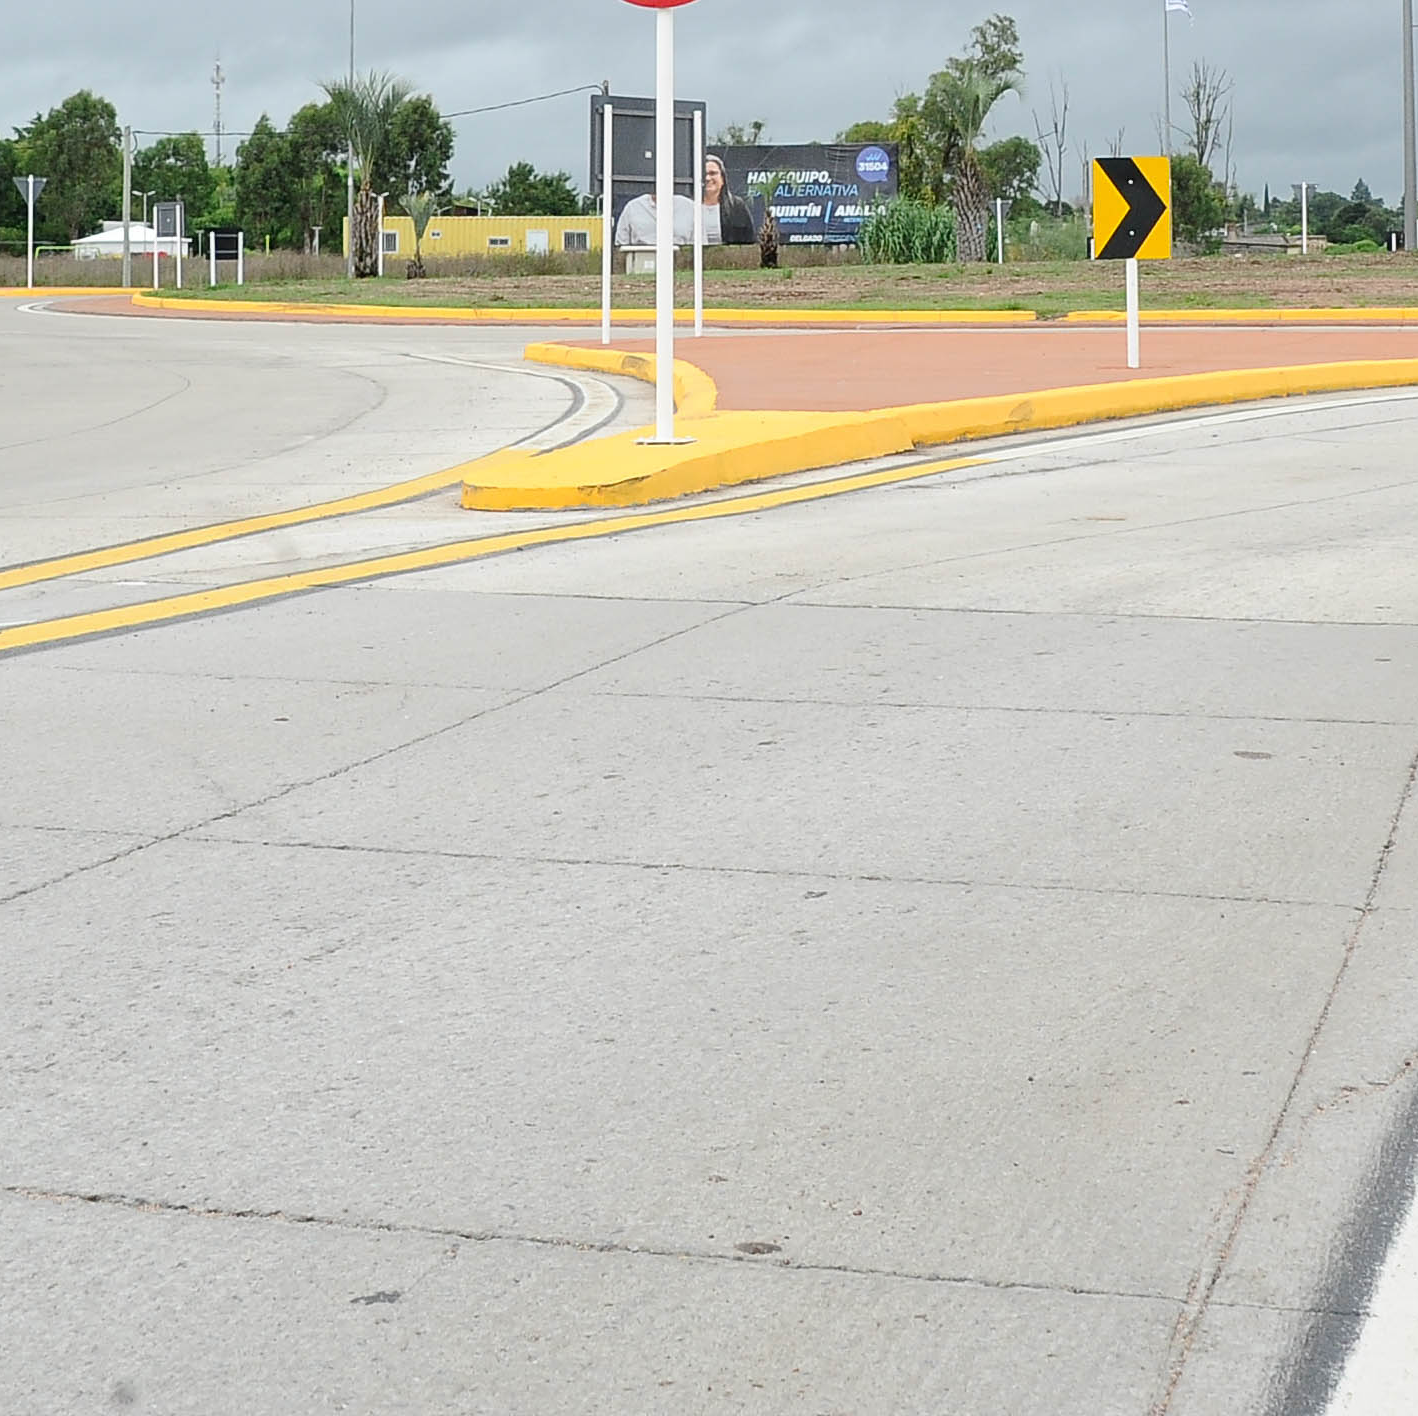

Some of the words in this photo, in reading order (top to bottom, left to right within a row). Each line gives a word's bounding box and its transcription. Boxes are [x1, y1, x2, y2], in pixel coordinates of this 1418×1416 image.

[747, 171, 776, 184] HAY
[774, 184, 859, 197] ALTERNATIVA
[834, 204, 886, 216] ANALA
